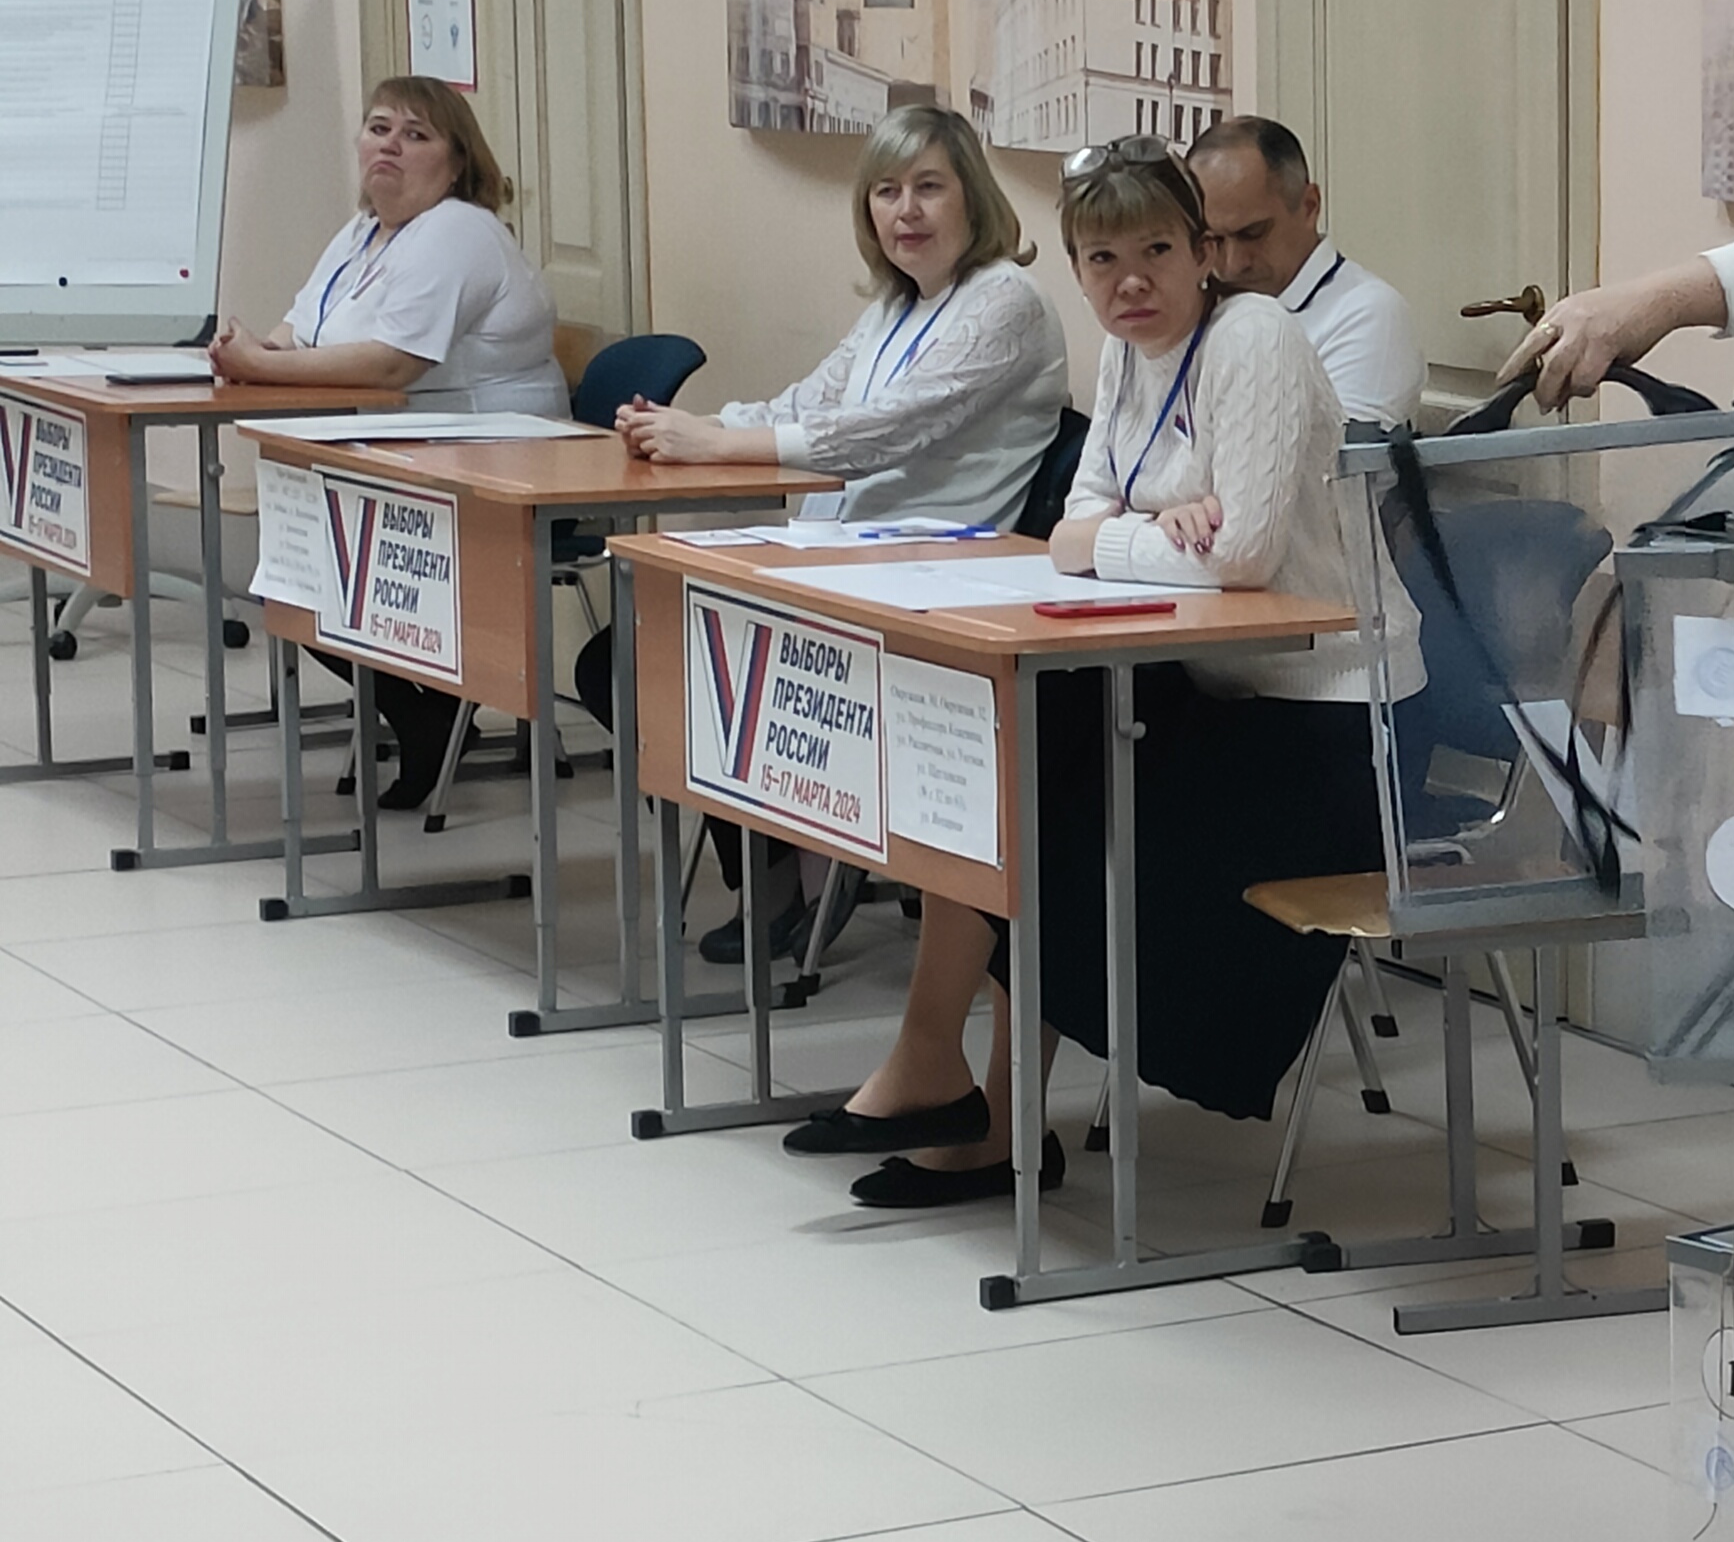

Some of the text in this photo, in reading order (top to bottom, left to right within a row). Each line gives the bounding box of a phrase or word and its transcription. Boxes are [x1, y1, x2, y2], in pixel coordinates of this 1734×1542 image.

[30, 481, 62, 515] РОССИИ
[382, 501, 435, 541] ВЫБОРЫ
[377, 539, 451, 585] ПРЕЗИДЕНТА
[373, 576, 420, 614] РОССИИ
[392, 620, 421, 648] МАРТА
[421, 626, 443, 655] 2024
[779, 632, 853, 685] ВЫБОРЫ
[772, 676, 875, 741] ПРЕЗИДЕНТА
[765, 720, 831, 772] РОССИИ
[792, 775, 832, 812] МАРТА
[832, 788, 862, 825] 2024
